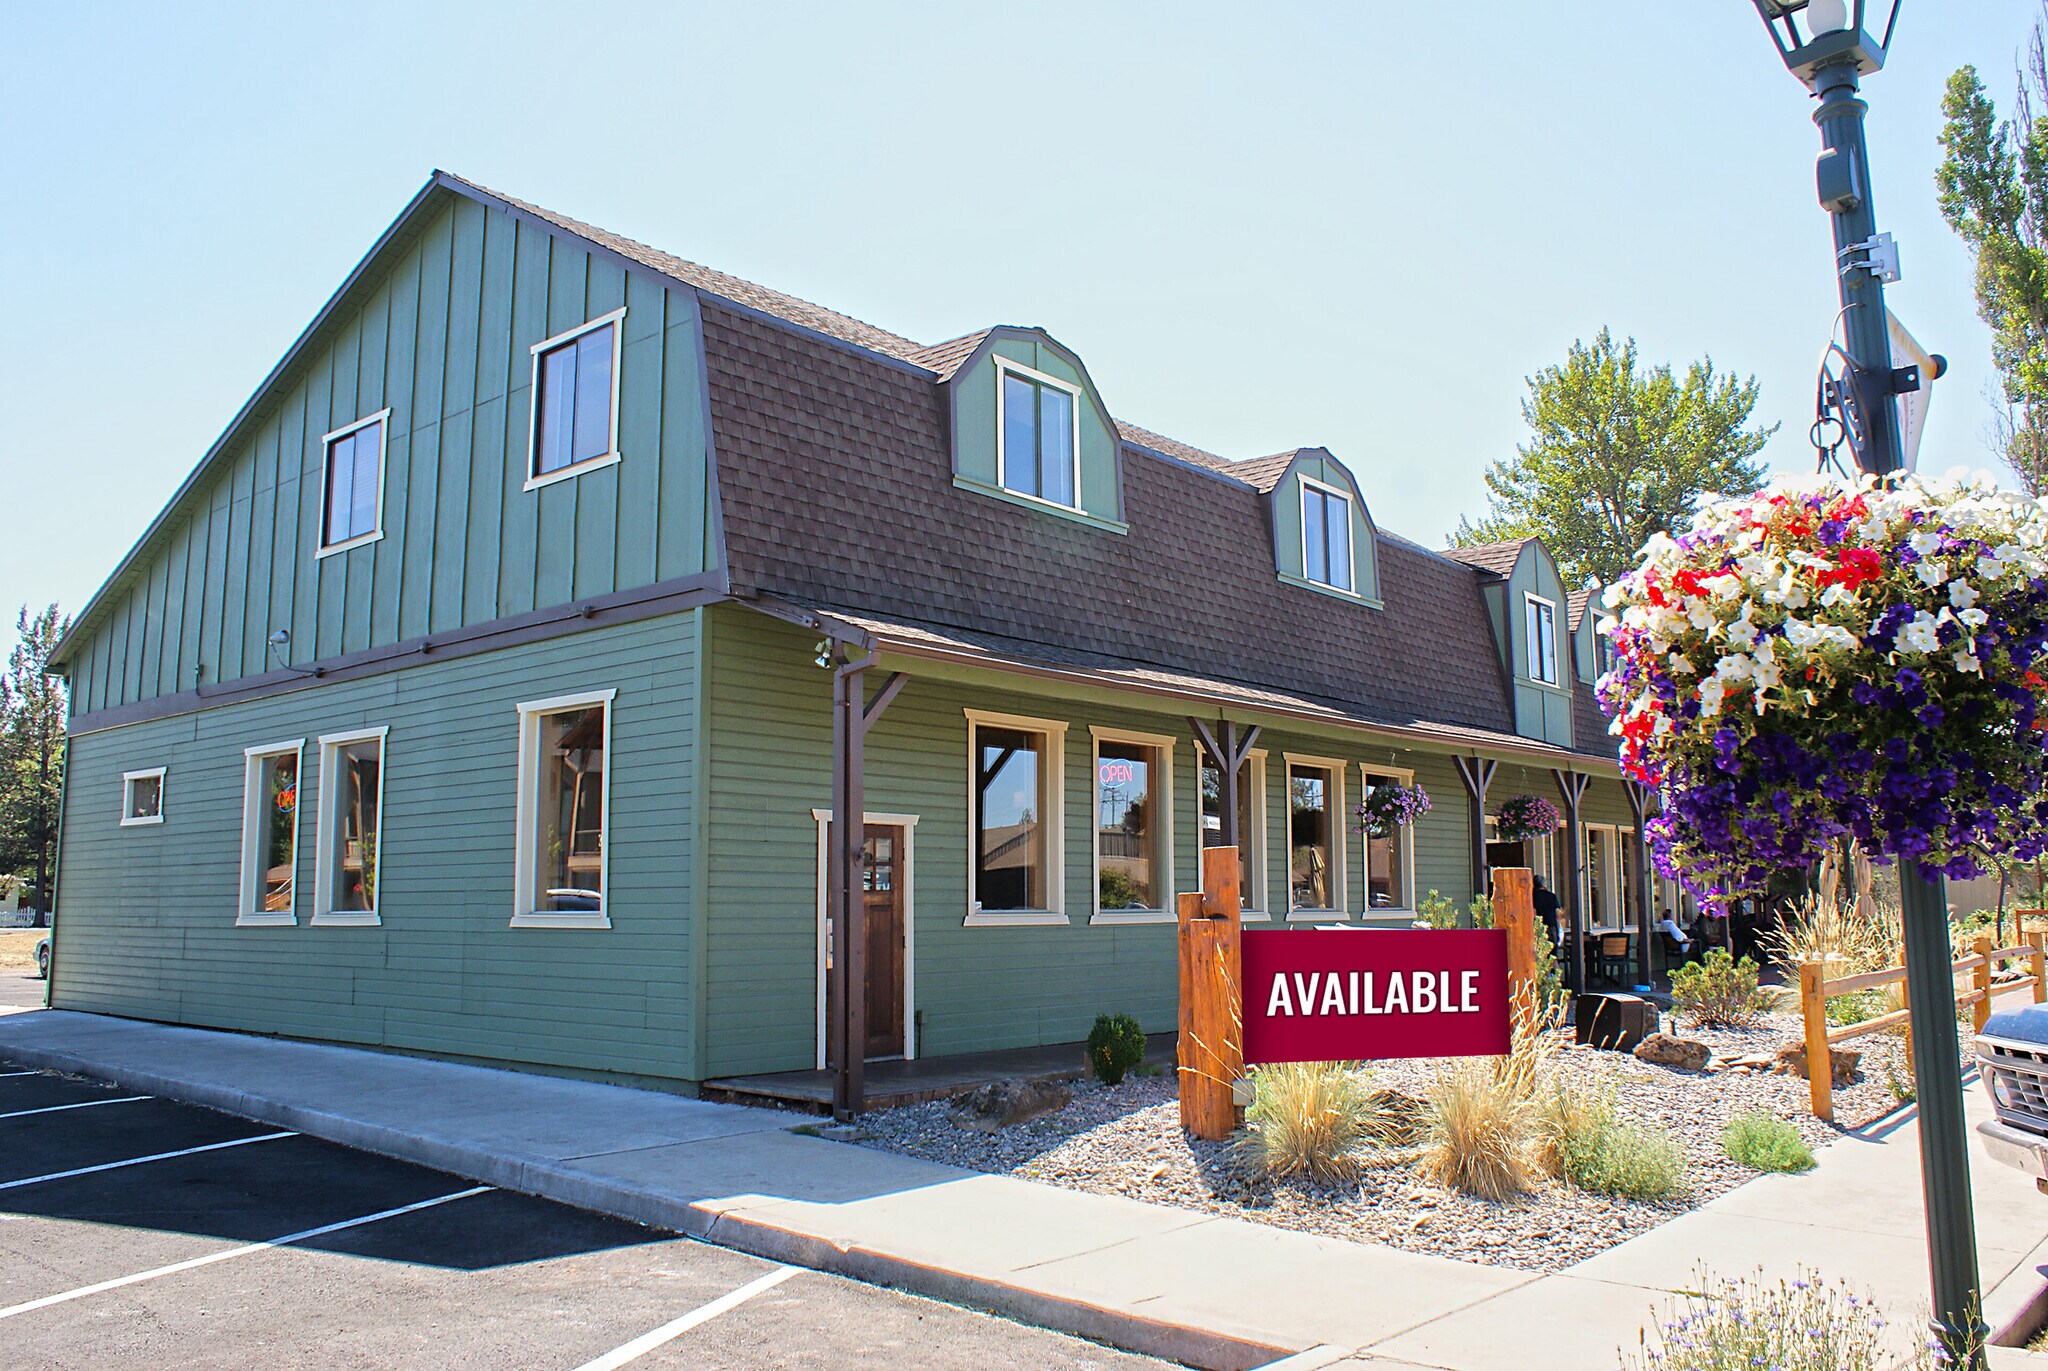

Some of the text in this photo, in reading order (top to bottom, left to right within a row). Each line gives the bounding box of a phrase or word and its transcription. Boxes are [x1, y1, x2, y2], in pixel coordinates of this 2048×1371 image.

[1099, 765, 1133, 782] OPEN
[276, 789, 297, 807] OPE
[1265, 970, 1480, 1017] AVAILABLE
